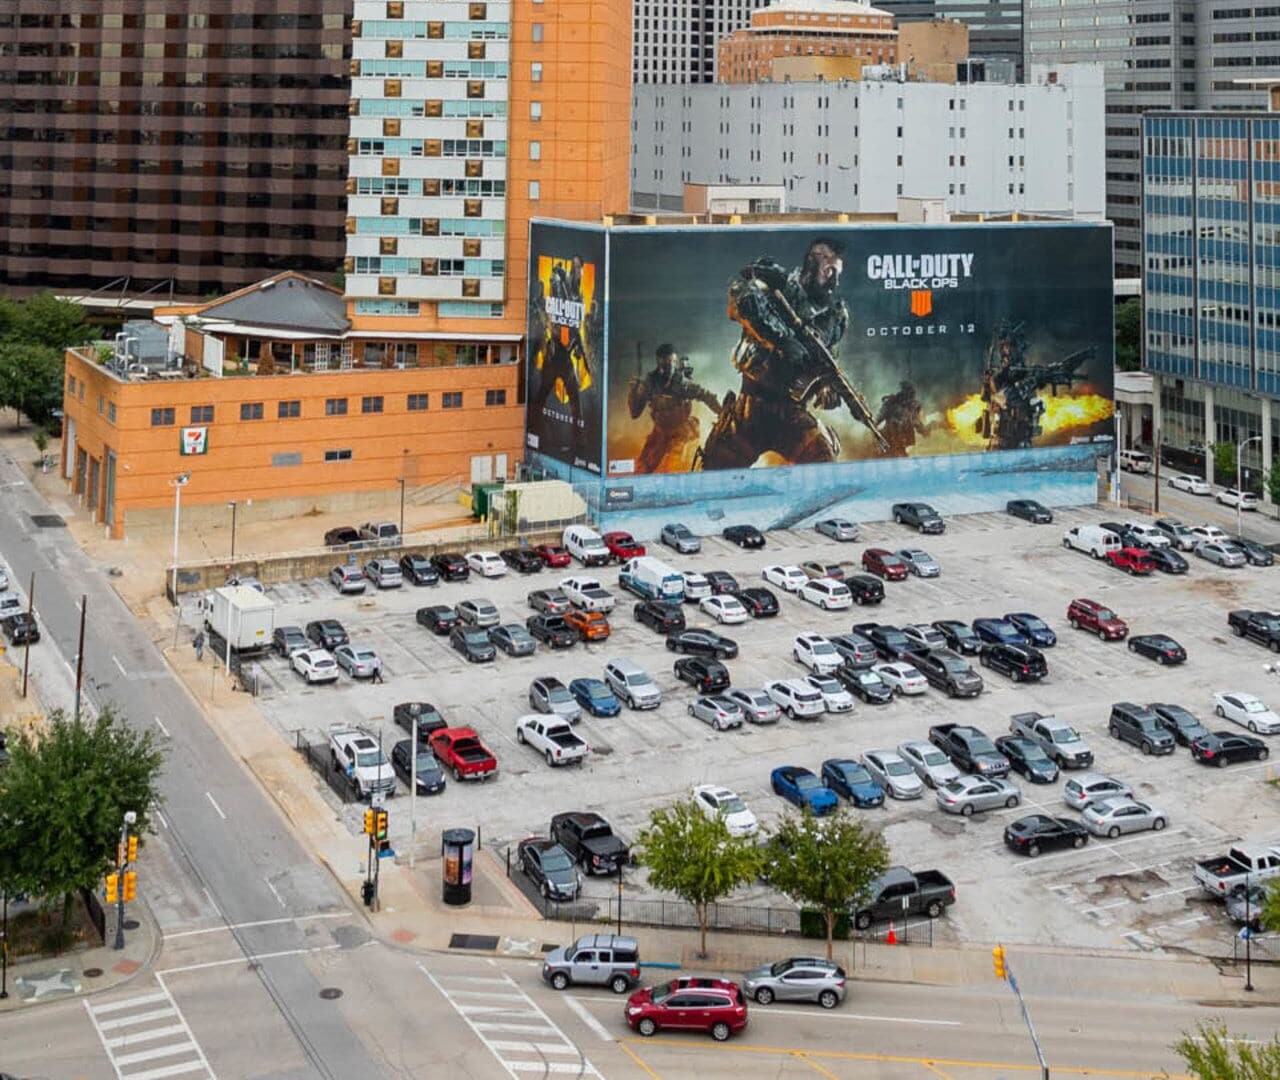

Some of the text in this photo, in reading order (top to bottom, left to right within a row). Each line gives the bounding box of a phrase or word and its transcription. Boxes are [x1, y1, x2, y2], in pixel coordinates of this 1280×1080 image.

[867, 254, 915, 279] CALL
[920, 253, 974, 278] DUTY
[884, 278, 958, 289] BLACK OPS
[867, 323, 975, 337] OCTOBER 12
